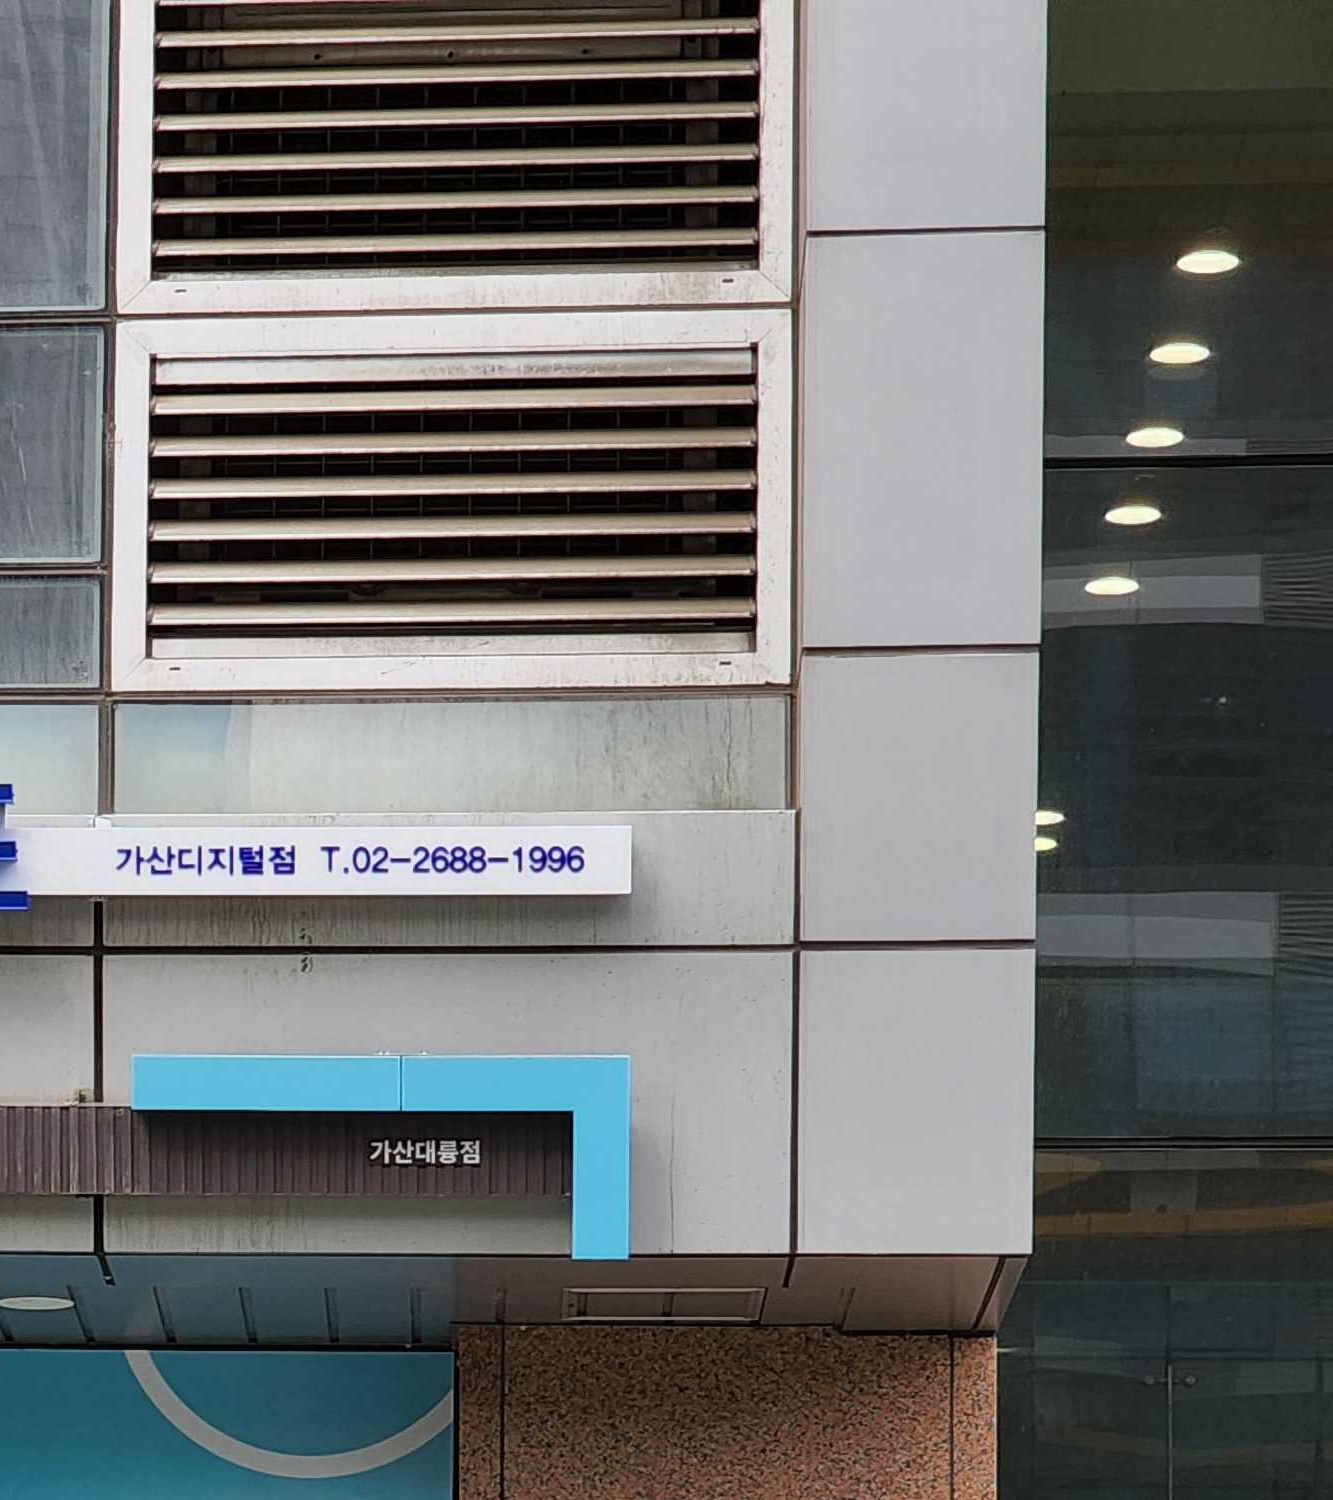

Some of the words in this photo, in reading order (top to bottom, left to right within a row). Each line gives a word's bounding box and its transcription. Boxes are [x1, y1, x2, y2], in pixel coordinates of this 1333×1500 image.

[115, 844, 298, 877] 가산디지털점
[320, 845, 586, 875] T.02-2688-1996
[369, 1139, 482, 1167] 가산대륭점
